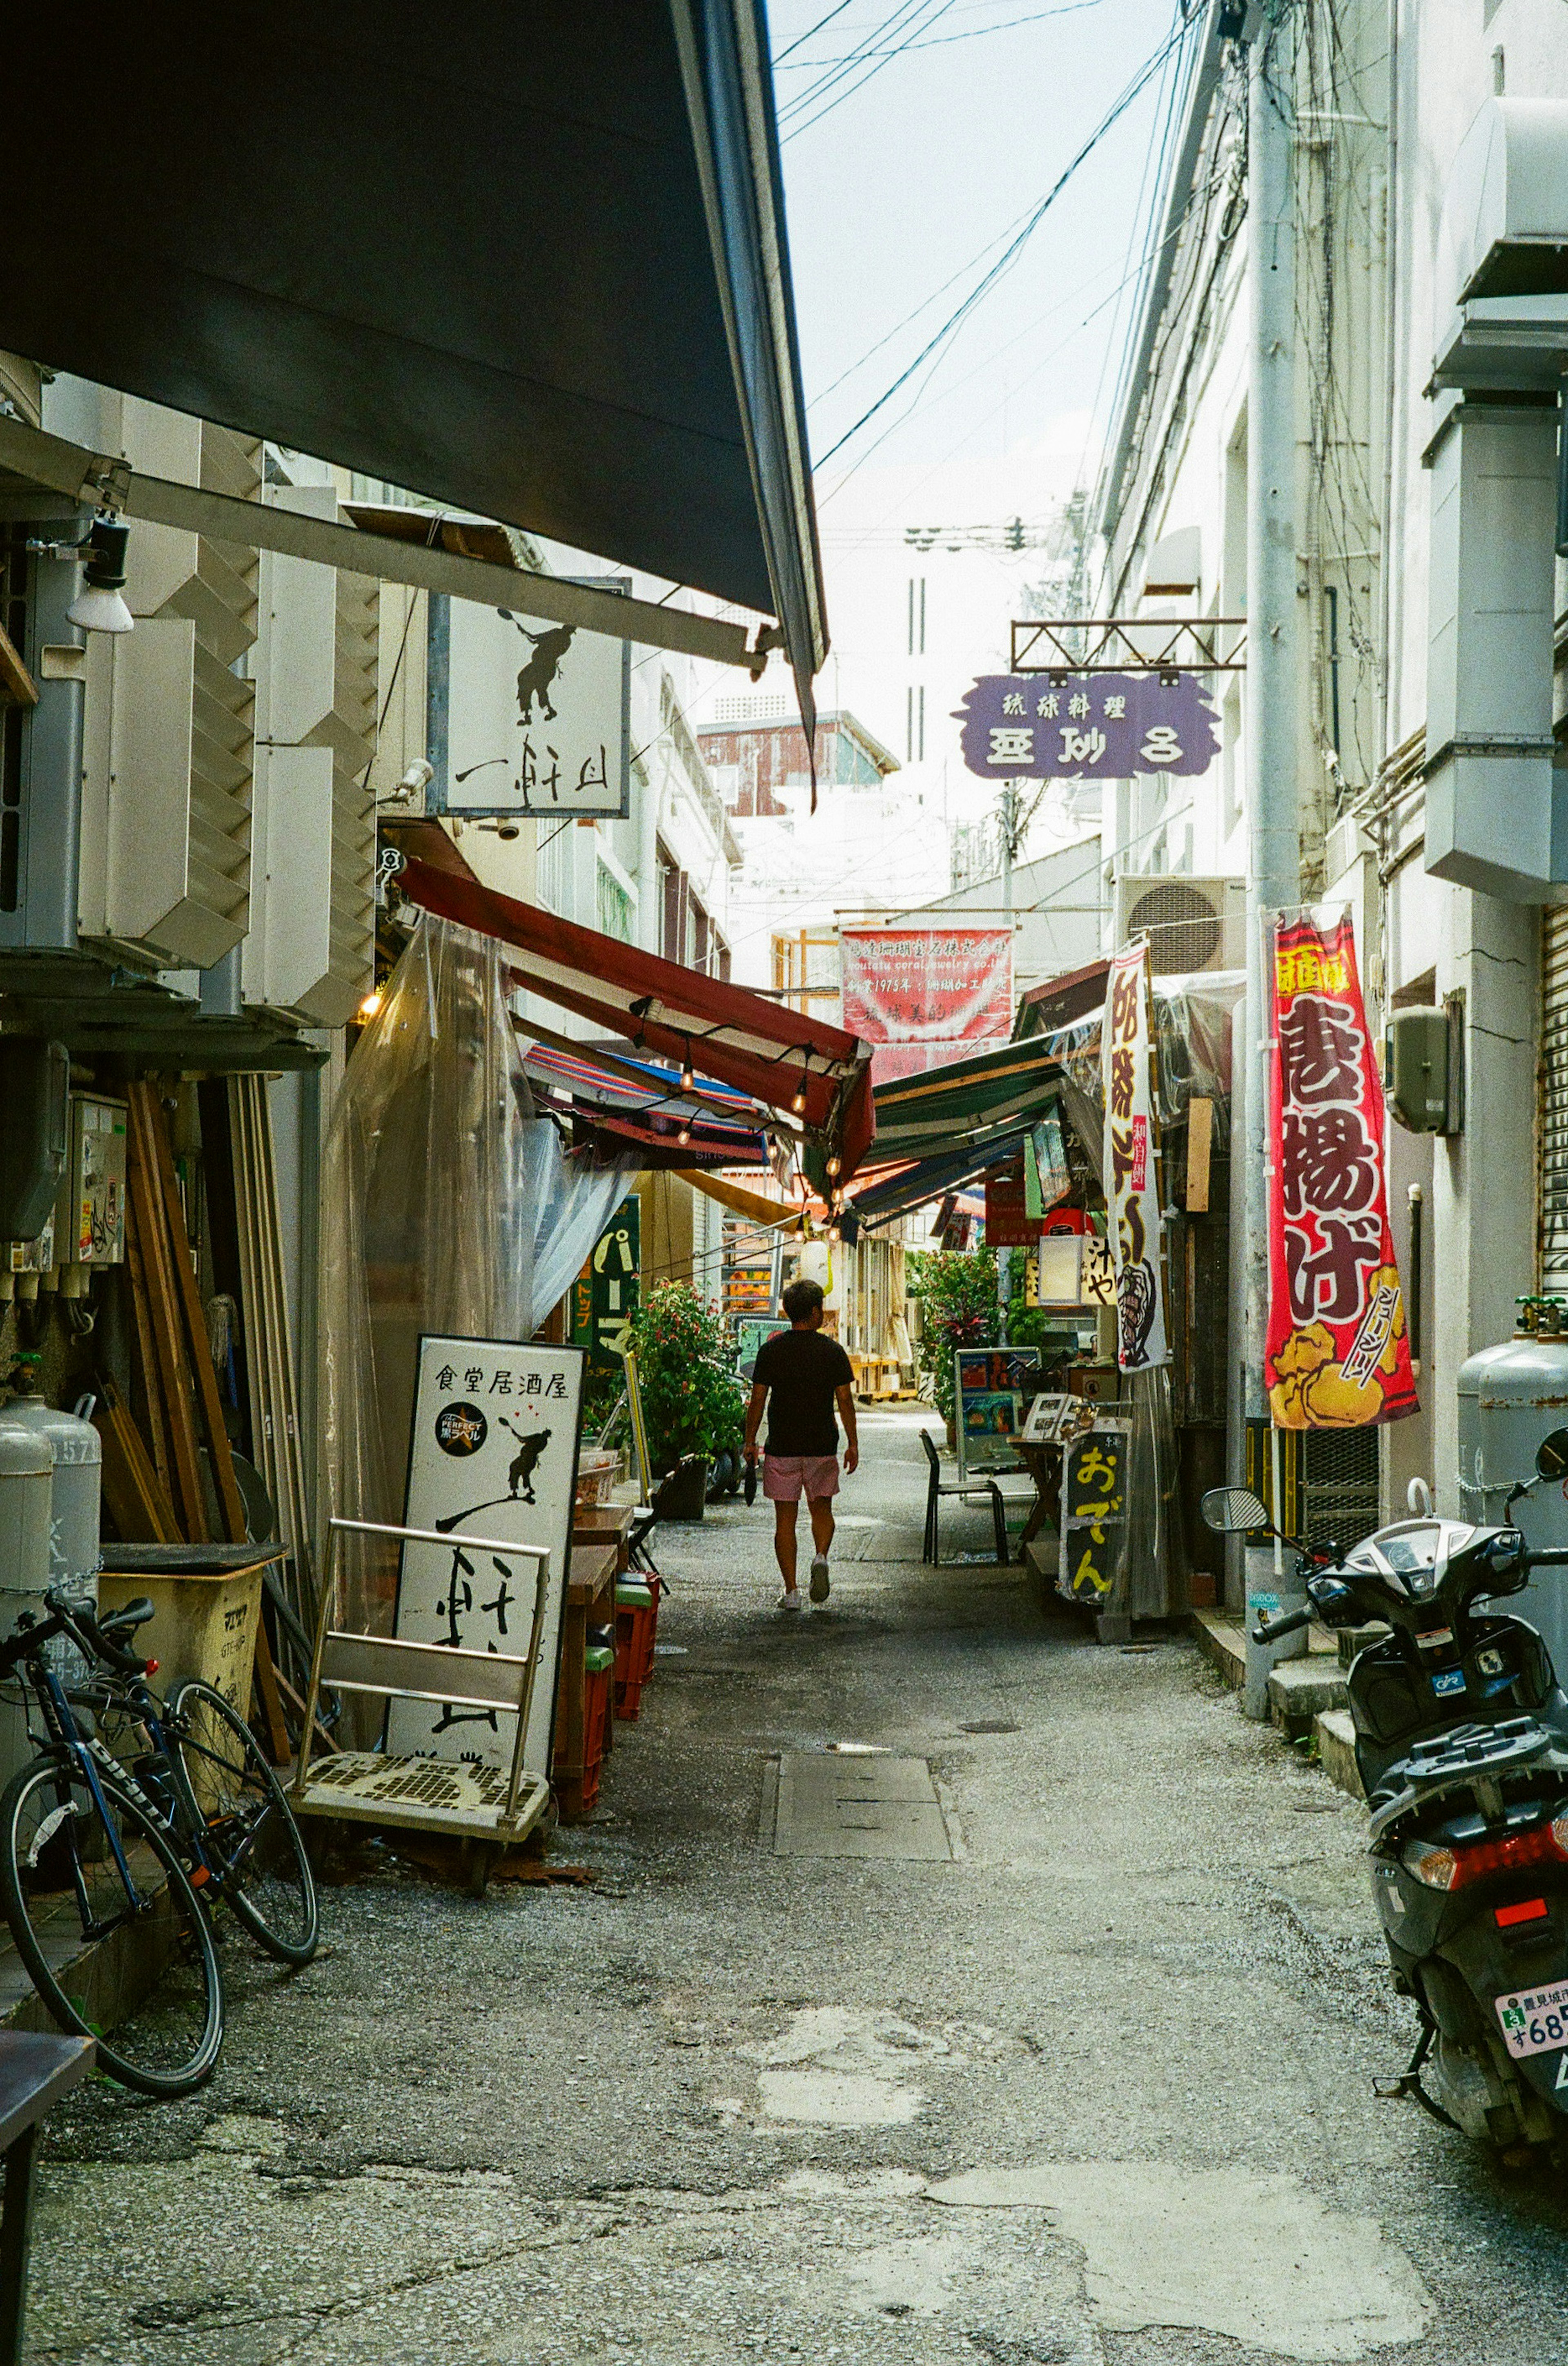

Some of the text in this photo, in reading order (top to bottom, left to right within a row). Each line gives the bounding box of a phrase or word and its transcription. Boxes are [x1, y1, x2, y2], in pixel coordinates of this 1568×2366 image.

[1002, 694, 1126, 720] 琉球料理
[895, 958, 924, 970] coral
[1278, 996, 1381, 1324] 唐揚げ
[436, 1365, 569, 1398] 食堂居酒屋
[440, 1427, 481, 1441] 黒ラベル
[442, 1420, 482, 1431] PERFECT
[1074, 1446, 1123, 1593] おでん
[1513, 2028, 1526, 2049] す
